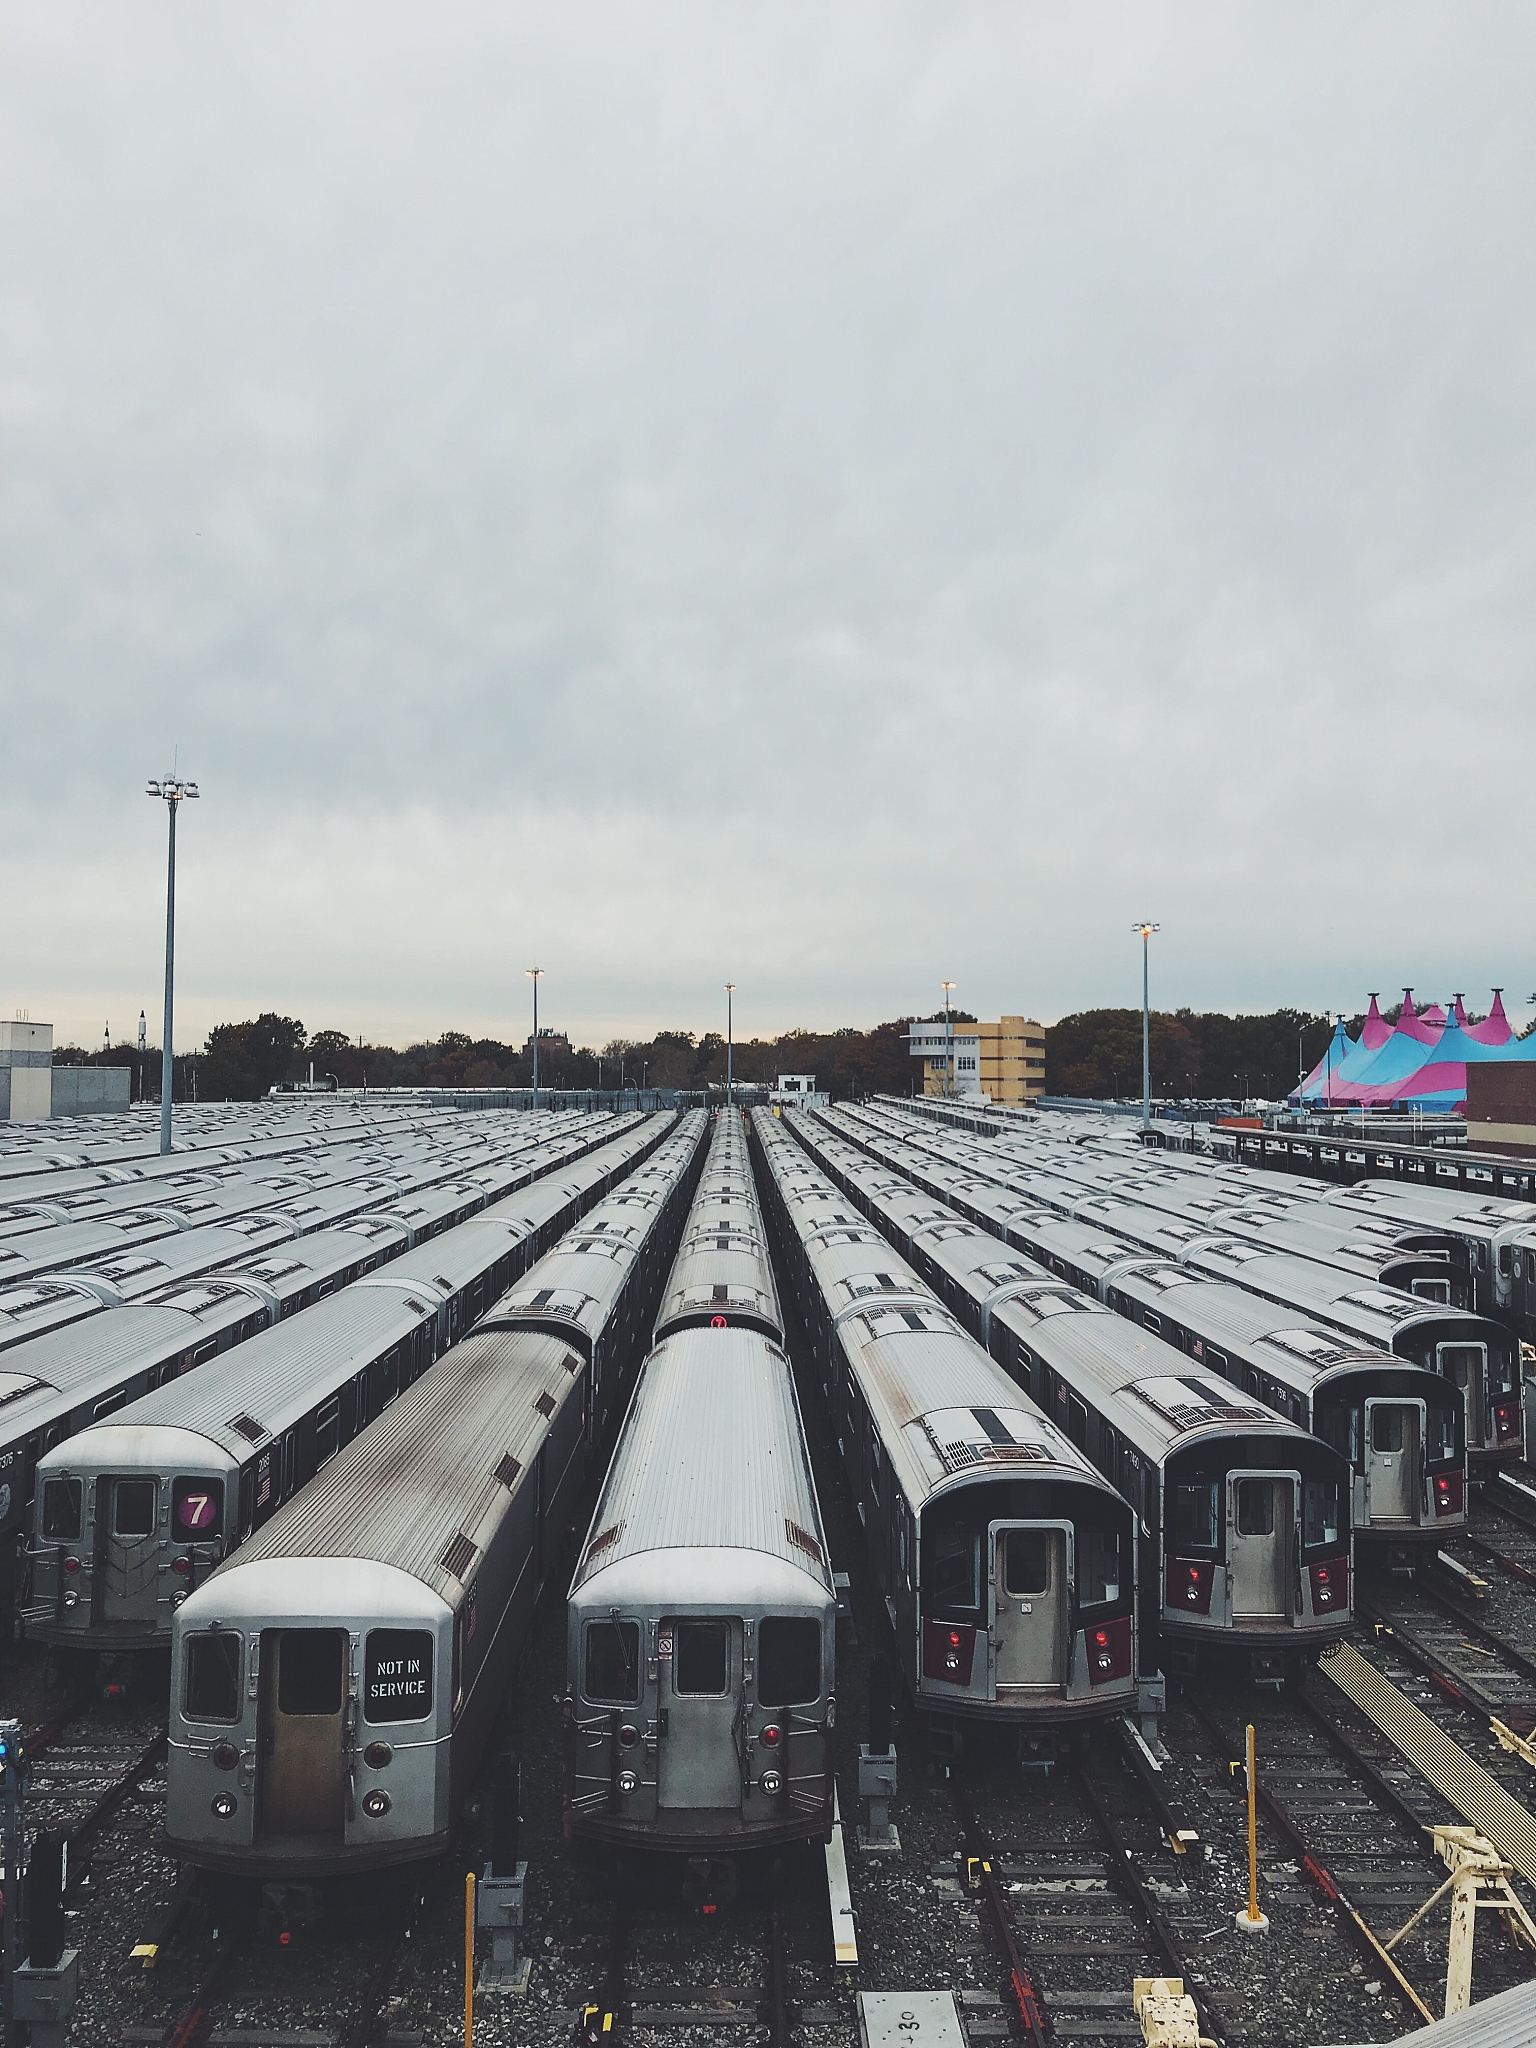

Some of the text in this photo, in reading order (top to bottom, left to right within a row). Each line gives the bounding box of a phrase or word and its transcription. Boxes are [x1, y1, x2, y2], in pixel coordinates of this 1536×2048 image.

[187, 1496, 208, 1525] 7
[377, 1659, 420, 1676] NOT IN
[370, 1680, 426, 1698] SERVICE
